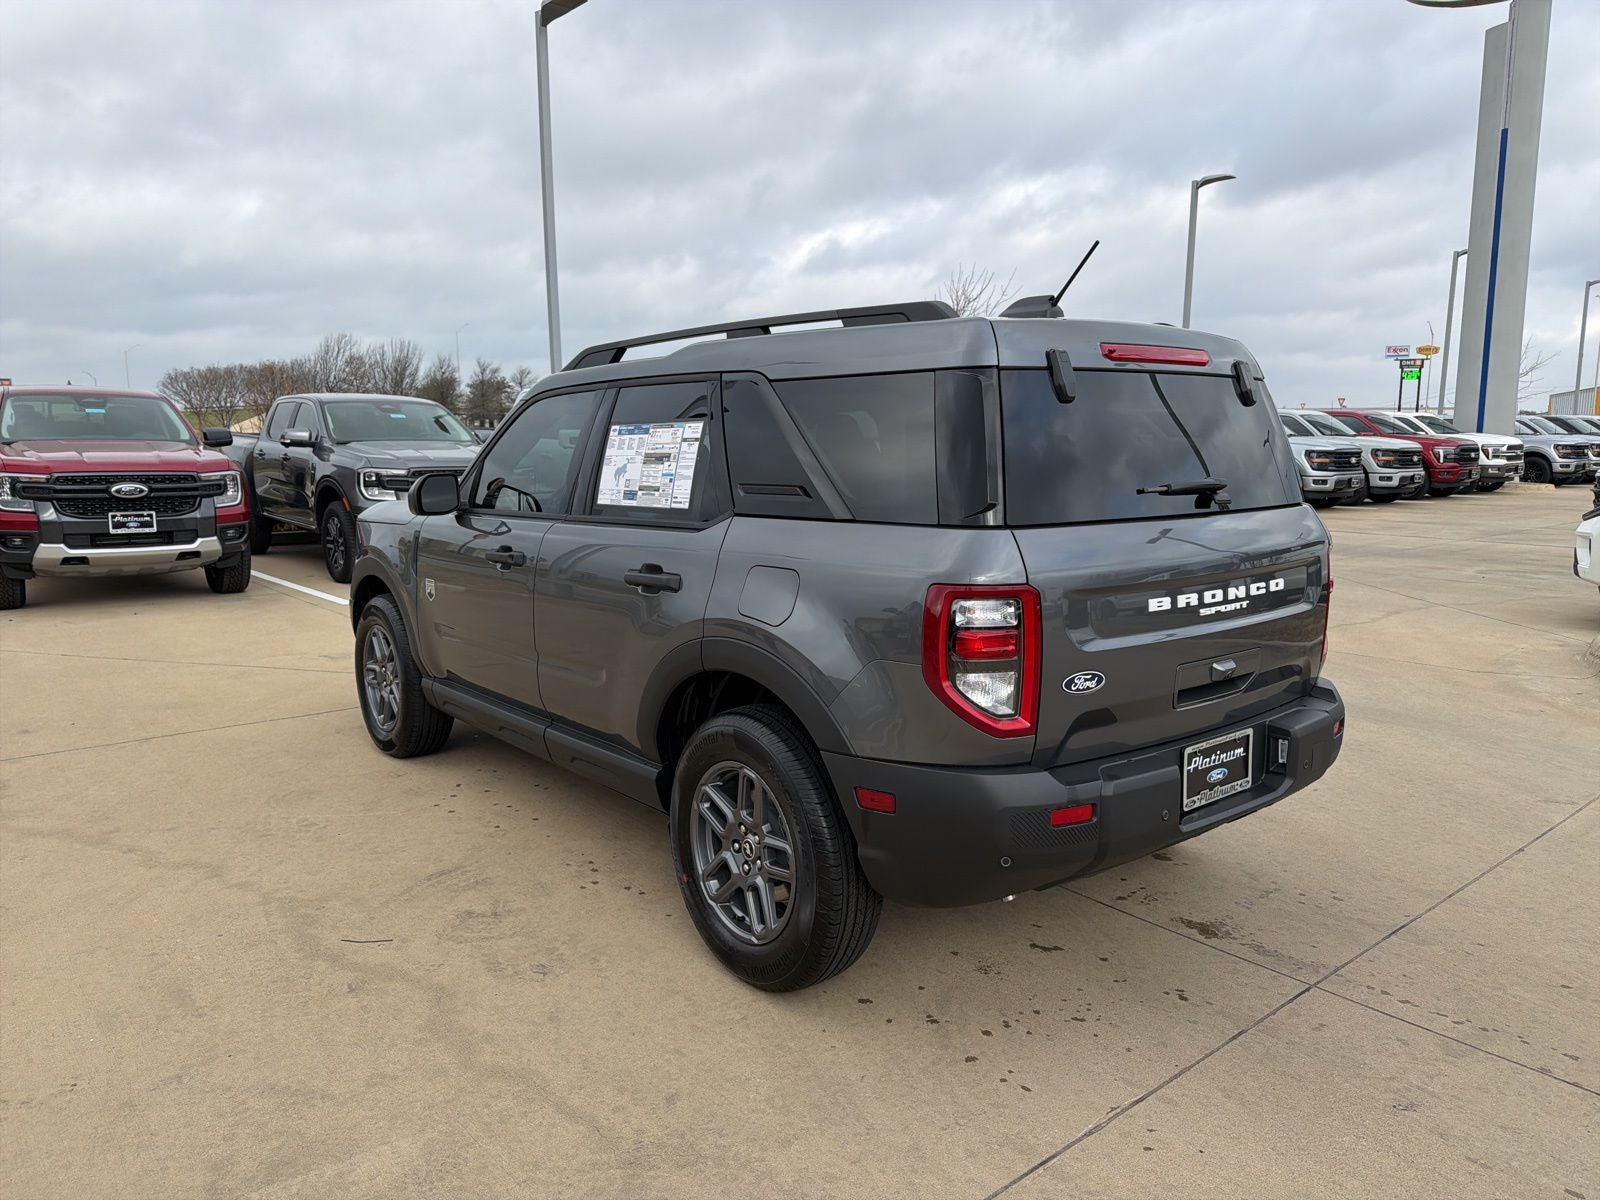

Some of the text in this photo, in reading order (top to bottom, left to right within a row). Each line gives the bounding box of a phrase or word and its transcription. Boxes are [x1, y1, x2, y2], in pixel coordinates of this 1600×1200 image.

[1148, 578, 1285, 612] BRONCO
[1199, 600, 1250, 616] SPORT
[1070, 674, 1099, 692] Ford
[1187, 747, 1246, 773] Platinum
